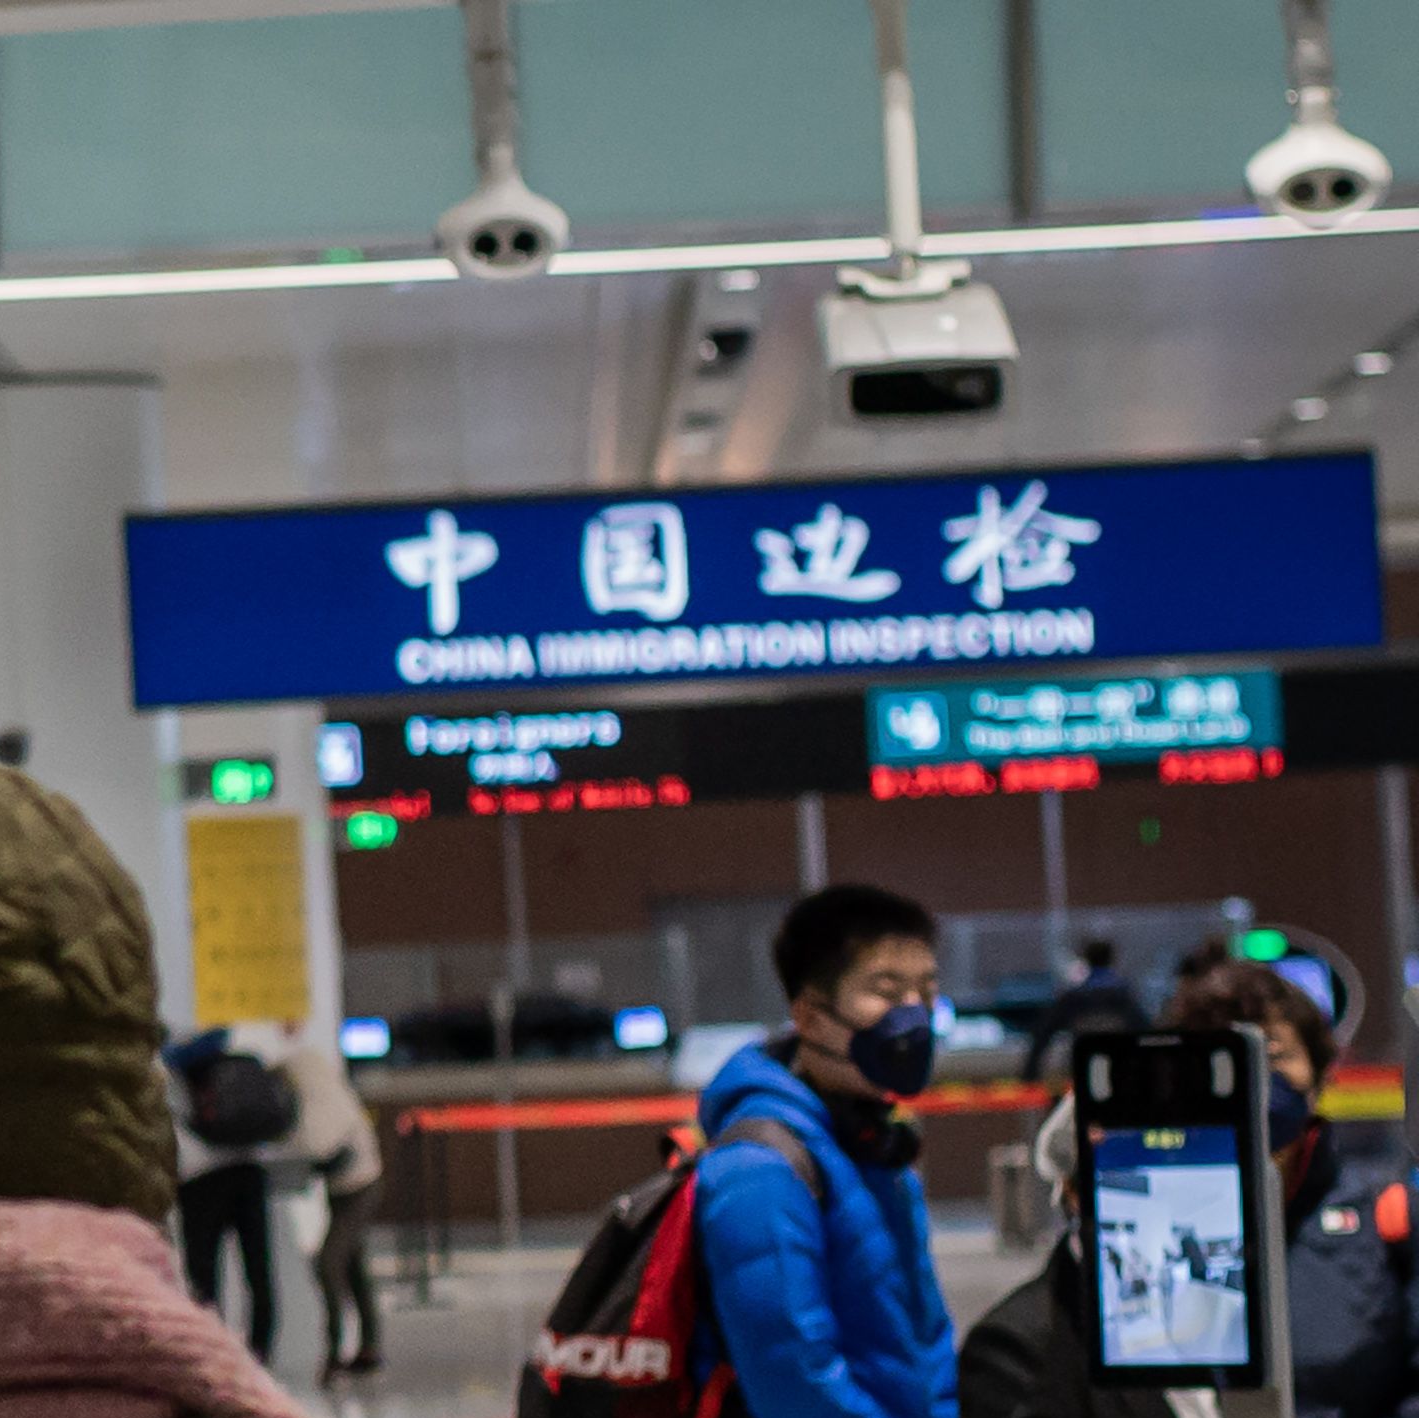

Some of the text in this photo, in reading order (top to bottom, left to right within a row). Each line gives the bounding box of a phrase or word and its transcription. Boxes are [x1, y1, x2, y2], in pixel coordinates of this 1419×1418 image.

[385, 479, 1102, 636] 中国边检
[396, 608, 1094, 683] CHINA IMMIGRATION INSPECTION
